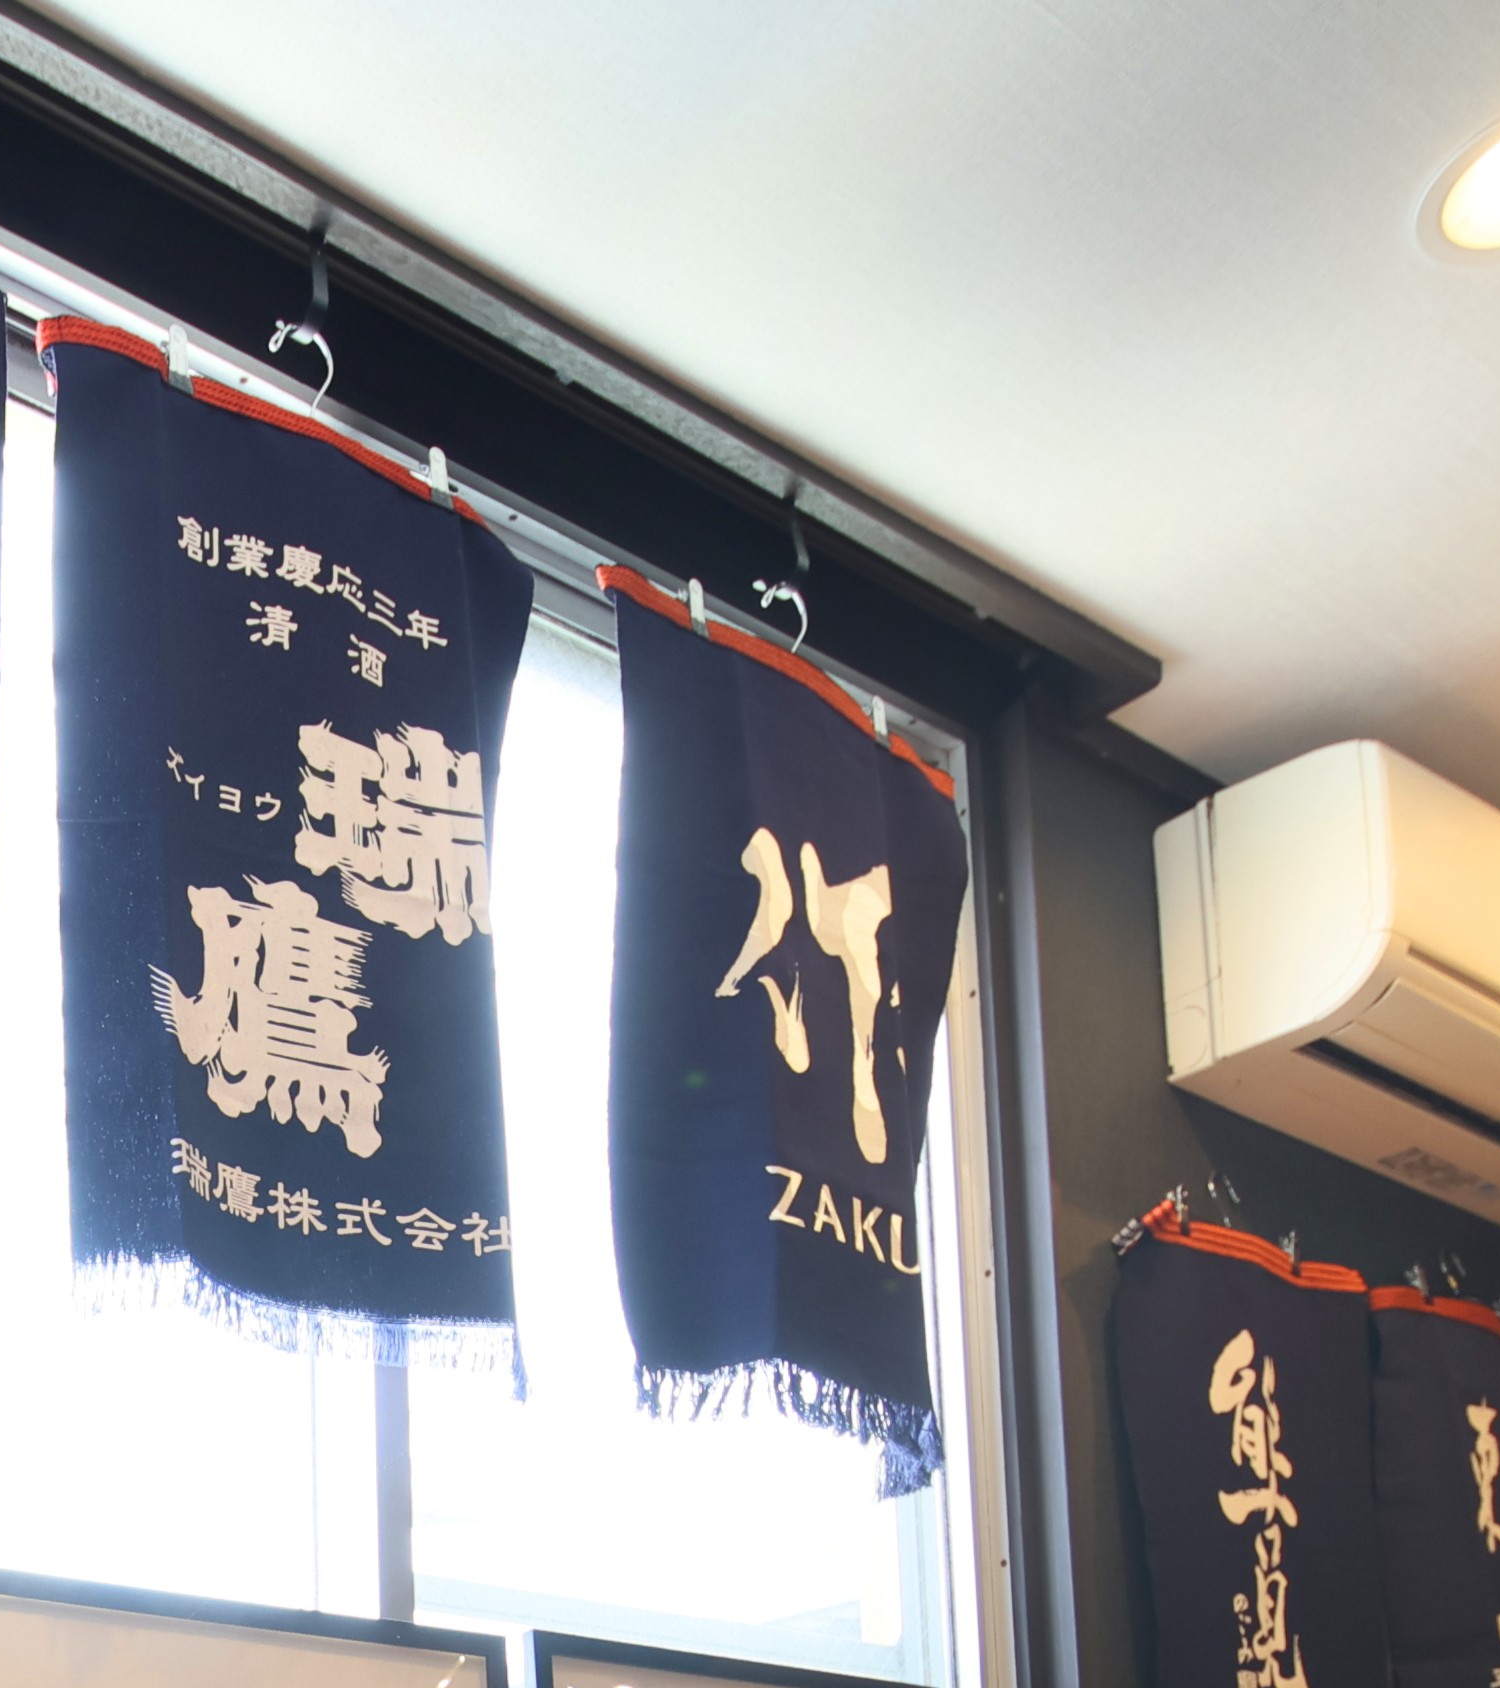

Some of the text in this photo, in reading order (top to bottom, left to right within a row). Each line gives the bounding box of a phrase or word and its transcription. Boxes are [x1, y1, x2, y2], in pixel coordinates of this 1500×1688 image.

[177, 515, 447, 651] 創業慶応三年
[246, 599, 386, 686] 清酒
[766, 1165, 921, 1276] ZAKU
